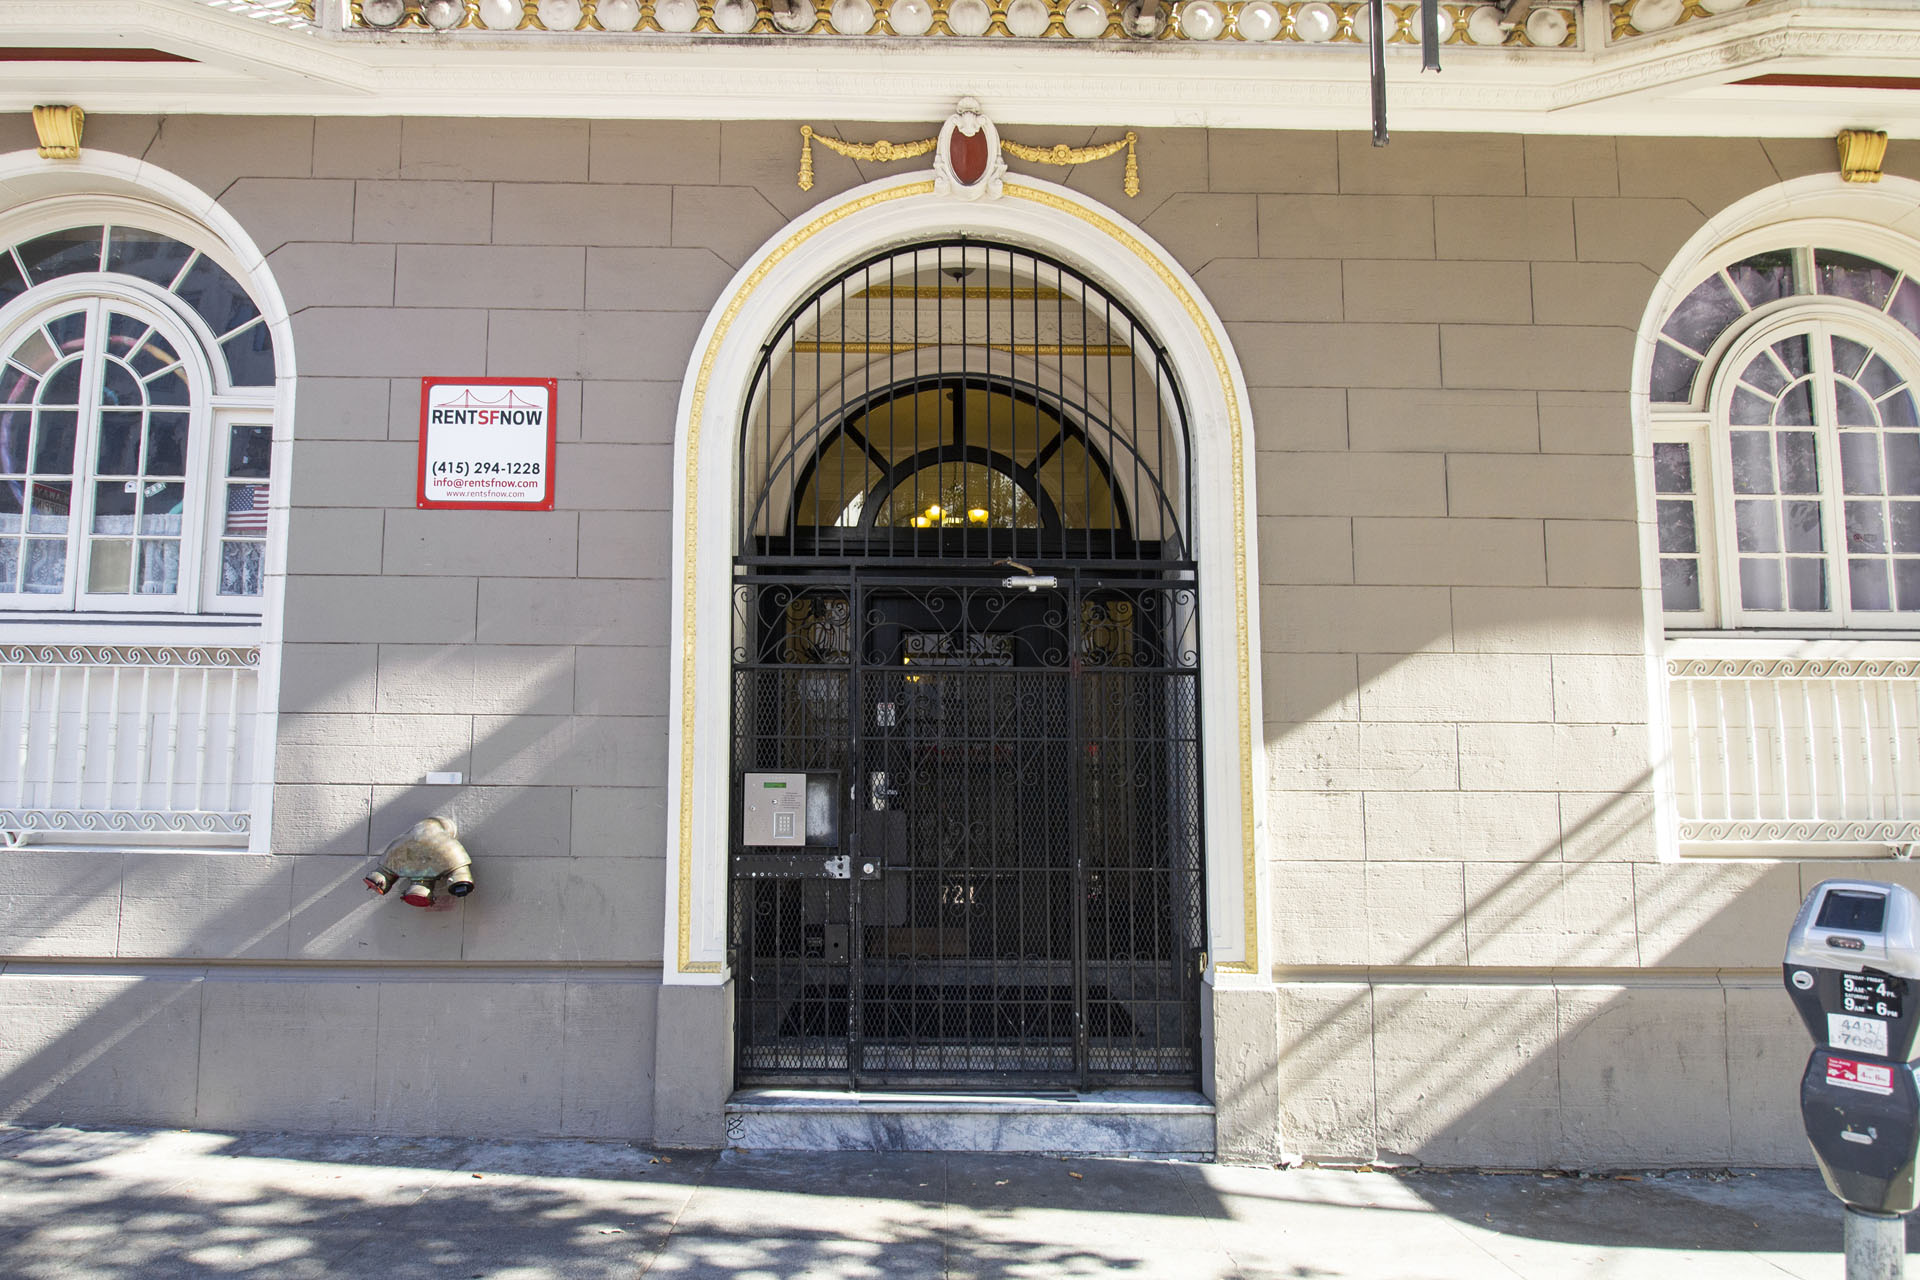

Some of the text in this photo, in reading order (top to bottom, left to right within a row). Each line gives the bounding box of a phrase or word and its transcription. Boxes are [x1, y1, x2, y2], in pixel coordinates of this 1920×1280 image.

[432, 410, 542, 425] RENTSFNOW
[432, 461, 540, 476] (415) 294-1228
[433, 477, 538, 488] info@rentsfnow.com
[447, 489, 525, 498] www.rentsfnow.com
